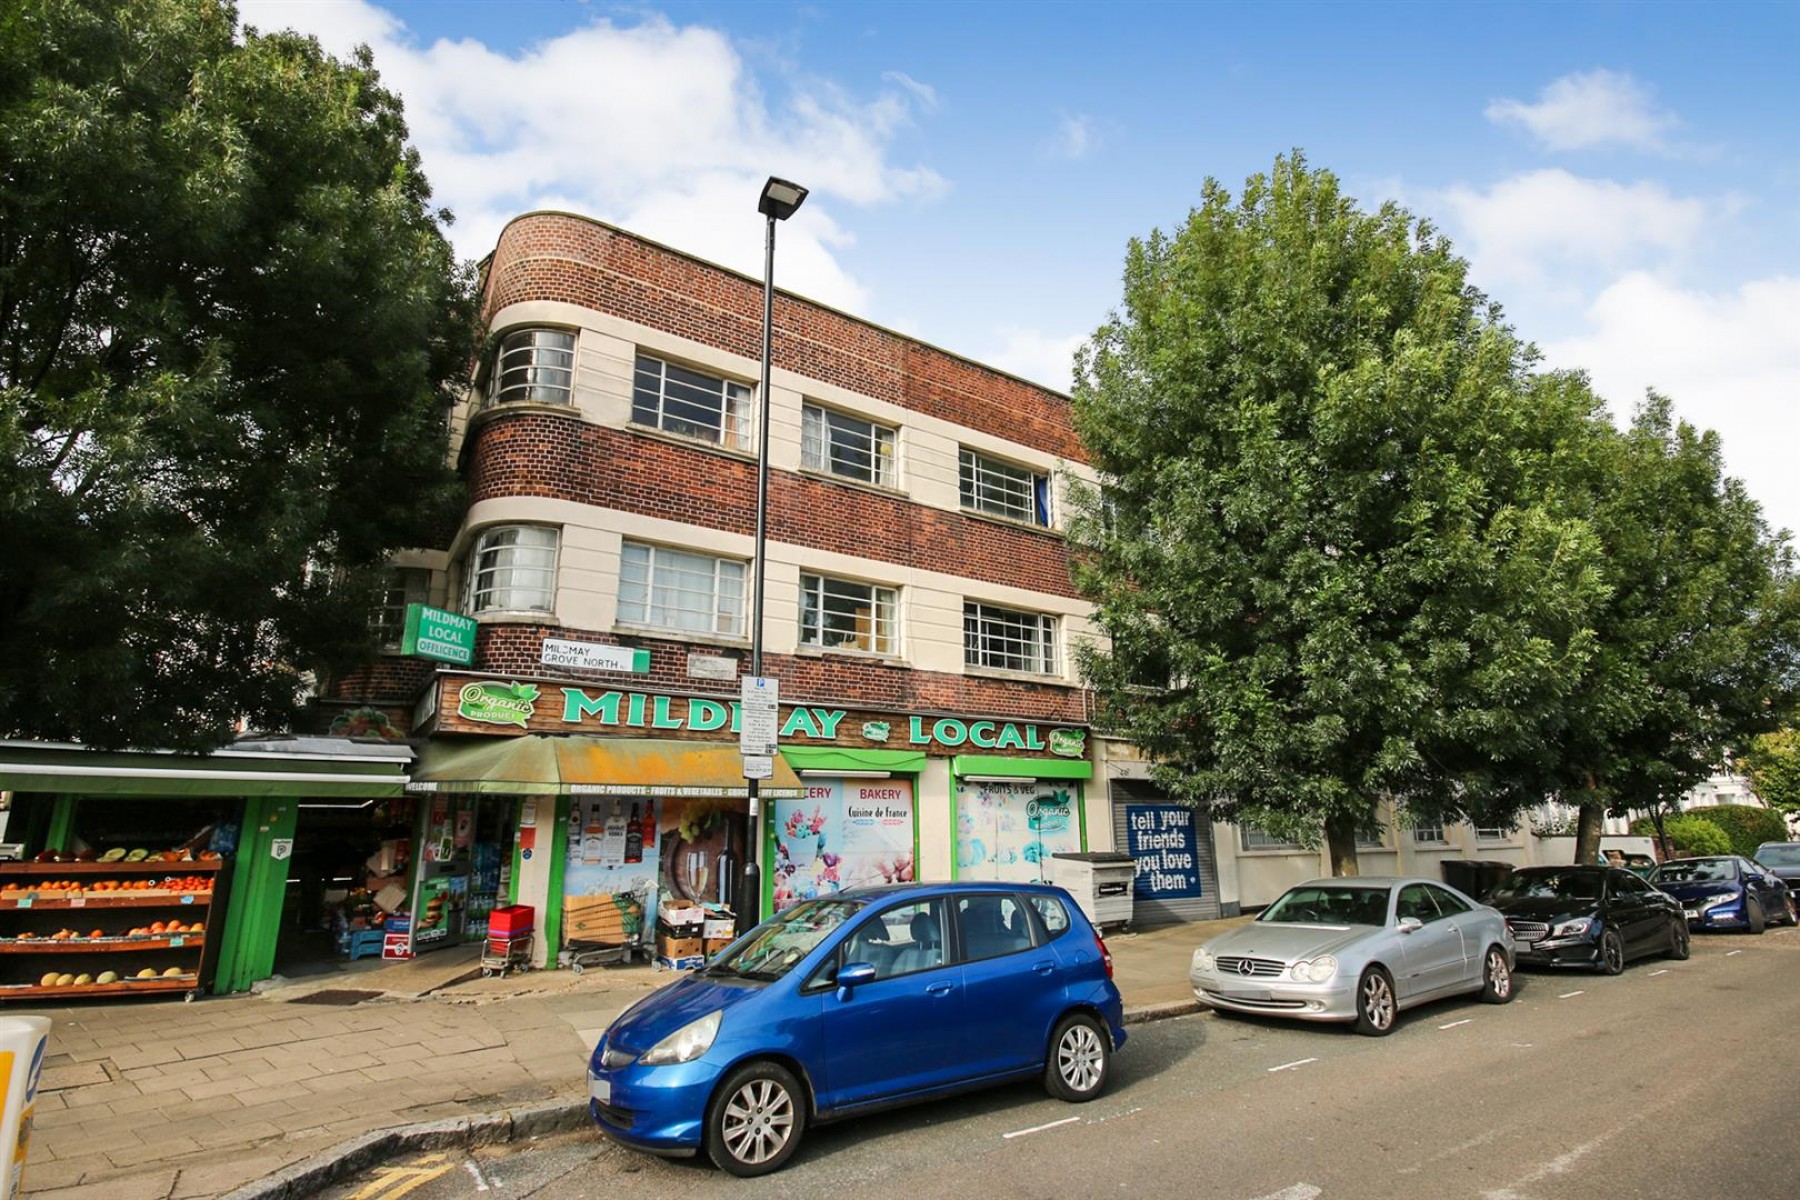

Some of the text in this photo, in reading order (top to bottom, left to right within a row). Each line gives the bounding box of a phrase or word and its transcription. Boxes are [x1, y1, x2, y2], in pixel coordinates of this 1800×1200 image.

[422, 607, 473, 631] MILDMAY
[429, 626, 463, 644] LOCAL
[419, 641, 469, 660] OFFLICENCE
[544, 654, 579, 665] GROVE
[584, 658, 619, 669] NORTH
[463, 684, 531, 713] Organic
[470, 710, 516, 720] PRODUCT
[560, 687, 847, 740] MILDAY
[909, 715, 1046, 751] LOCAL
[570, 784, 606, 795] ORGANIC
[606, 785, 645, 796] PRODUCTS
[727, 788, 749, 797] GROCE
[860, 788, 901, 800] BAKERY
[984, 784, 1012, 794] FRUITS
[1020, 786, 1035, 794] VEG
[848, 805, 873, 818] Cuisine
[875, 806, 884, 818] de
[1131, 810, 1190, 831] tell your
[1137, 828, 1186, 851] friends
[1134, 849, 1192, 878] you love
[1150, 870, 1187, 892] them
